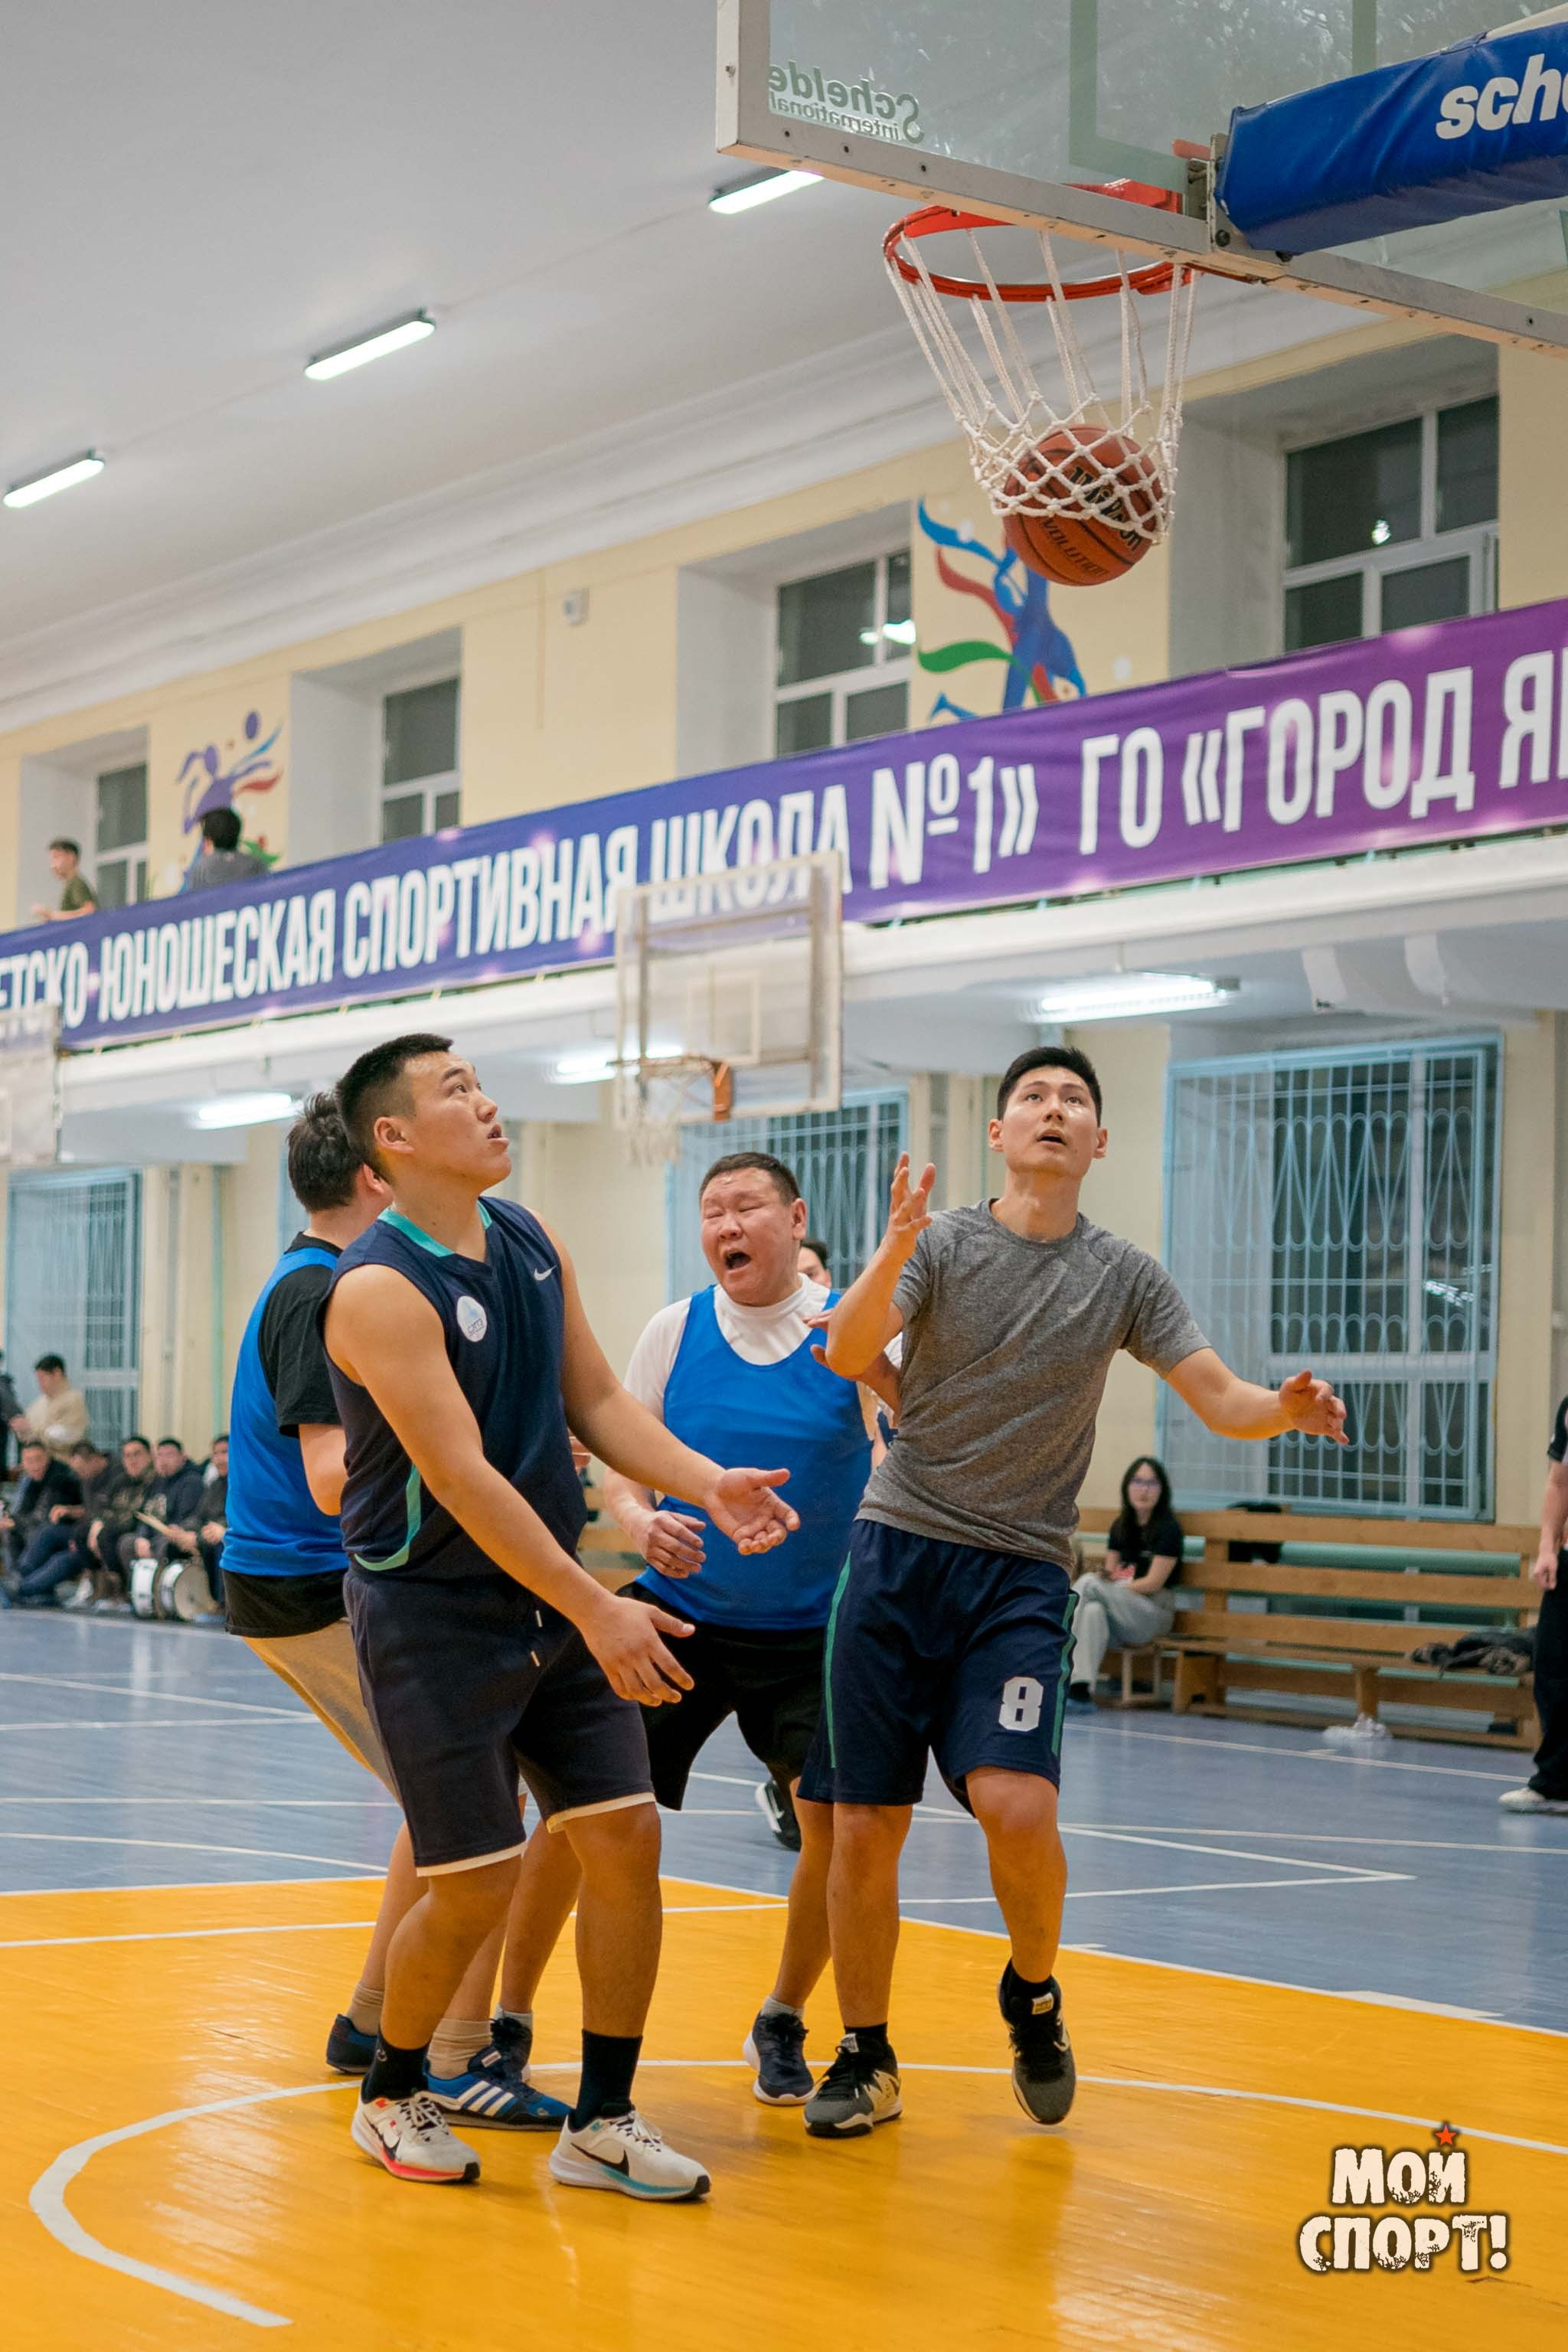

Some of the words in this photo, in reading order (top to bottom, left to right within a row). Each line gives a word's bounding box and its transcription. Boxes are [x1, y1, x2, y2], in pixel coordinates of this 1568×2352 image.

[1435, 53, 1568, 140] sch
[1041, 516, 1109, 577] VOLUTION
[342, 825, 639, 979] СПОРТИВНАЯ
[648, 783, 853, 923] ШКОЛА
[1079, 726, 1165, 856] ГО
[1181, 665, 1476, 833] «ГОРОД
[998, 1675, 1044, 1733] 8
